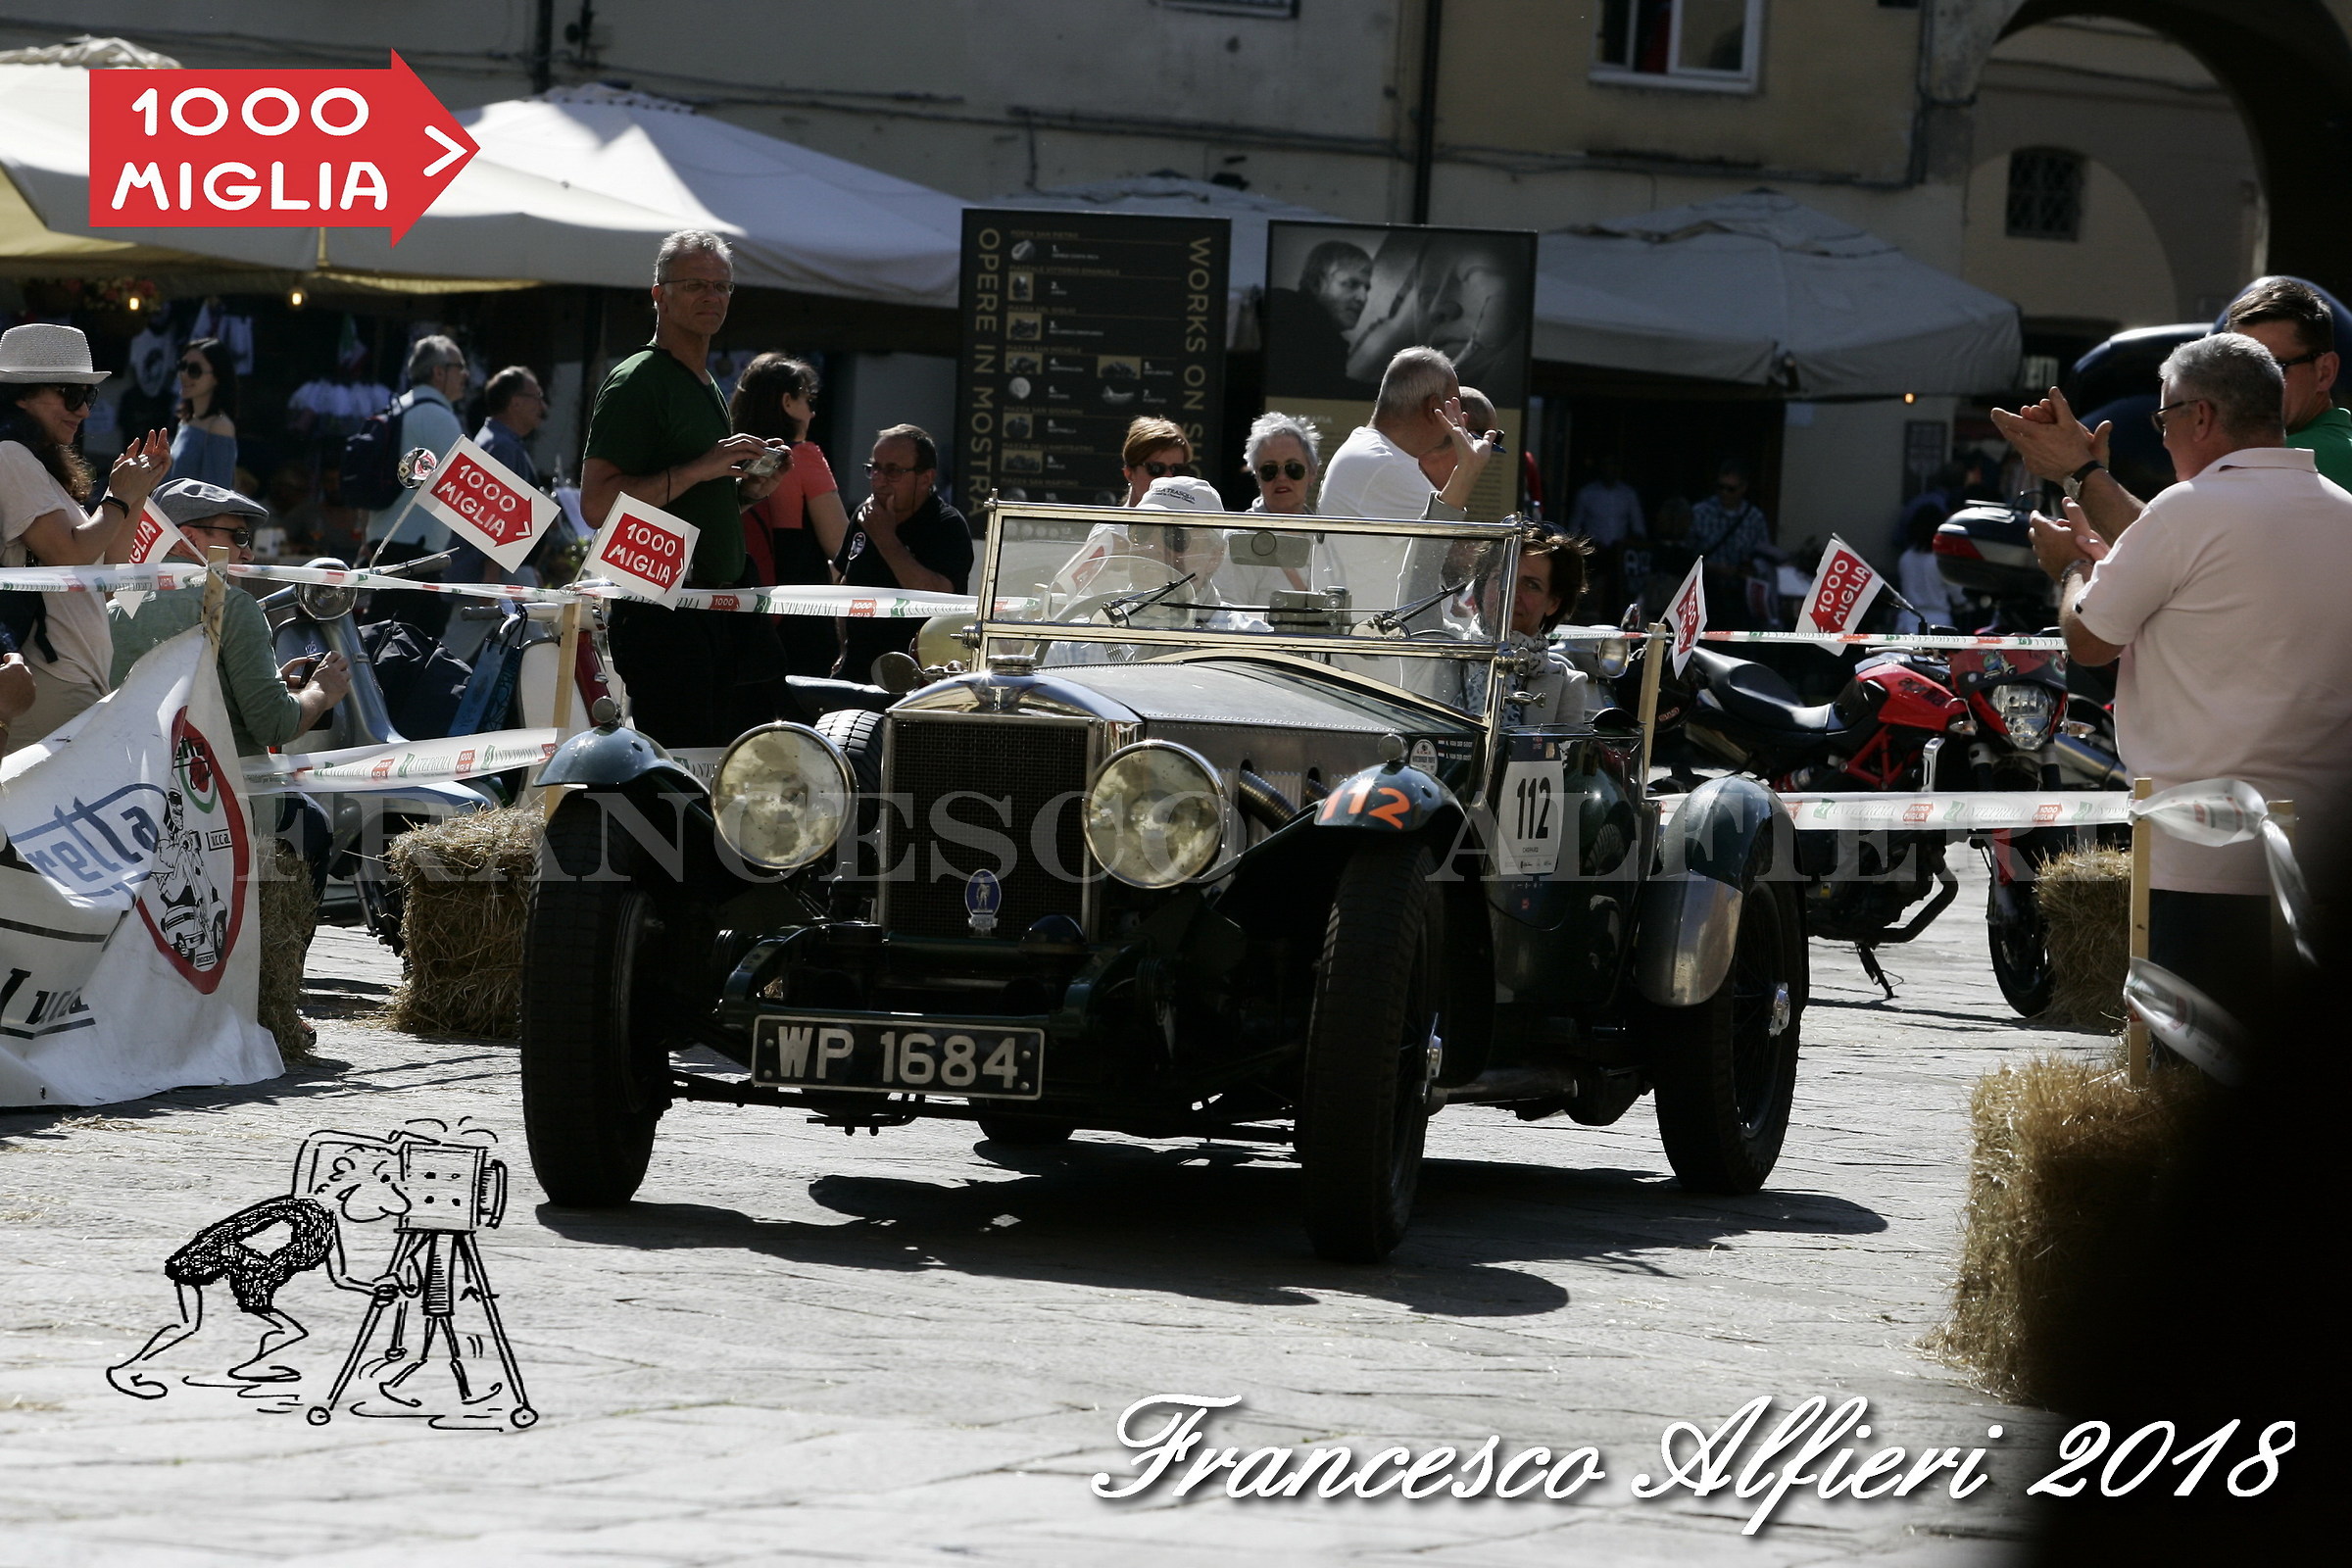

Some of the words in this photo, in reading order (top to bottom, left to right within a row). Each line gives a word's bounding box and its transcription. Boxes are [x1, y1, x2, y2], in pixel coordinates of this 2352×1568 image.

[976, 228, 1001, 332] OPERE
[1185, 237, 1211, 353] WORKS
[973, 344, 996, 373] IN
[1182, 365, 1205, 410] ON
[968, 386, 995, 516] MOSTRA
[436, 480, 507, 538] MIGLIA
[459, 465, 517, 514] 1000
[607, 543, 671, 585] MIGLIA
[626, 522, 678, 558] 1000
[1818, 559, 1849, 613] 1000
[1833, 565, 1871, 626] MIGLIA
[1320, 787, 1411, 830] 112
[1516, 777, 1551, 840] 112
[778, 1026, 855, 1079] WP
[880, 1031, 1018, 1089] 1684
